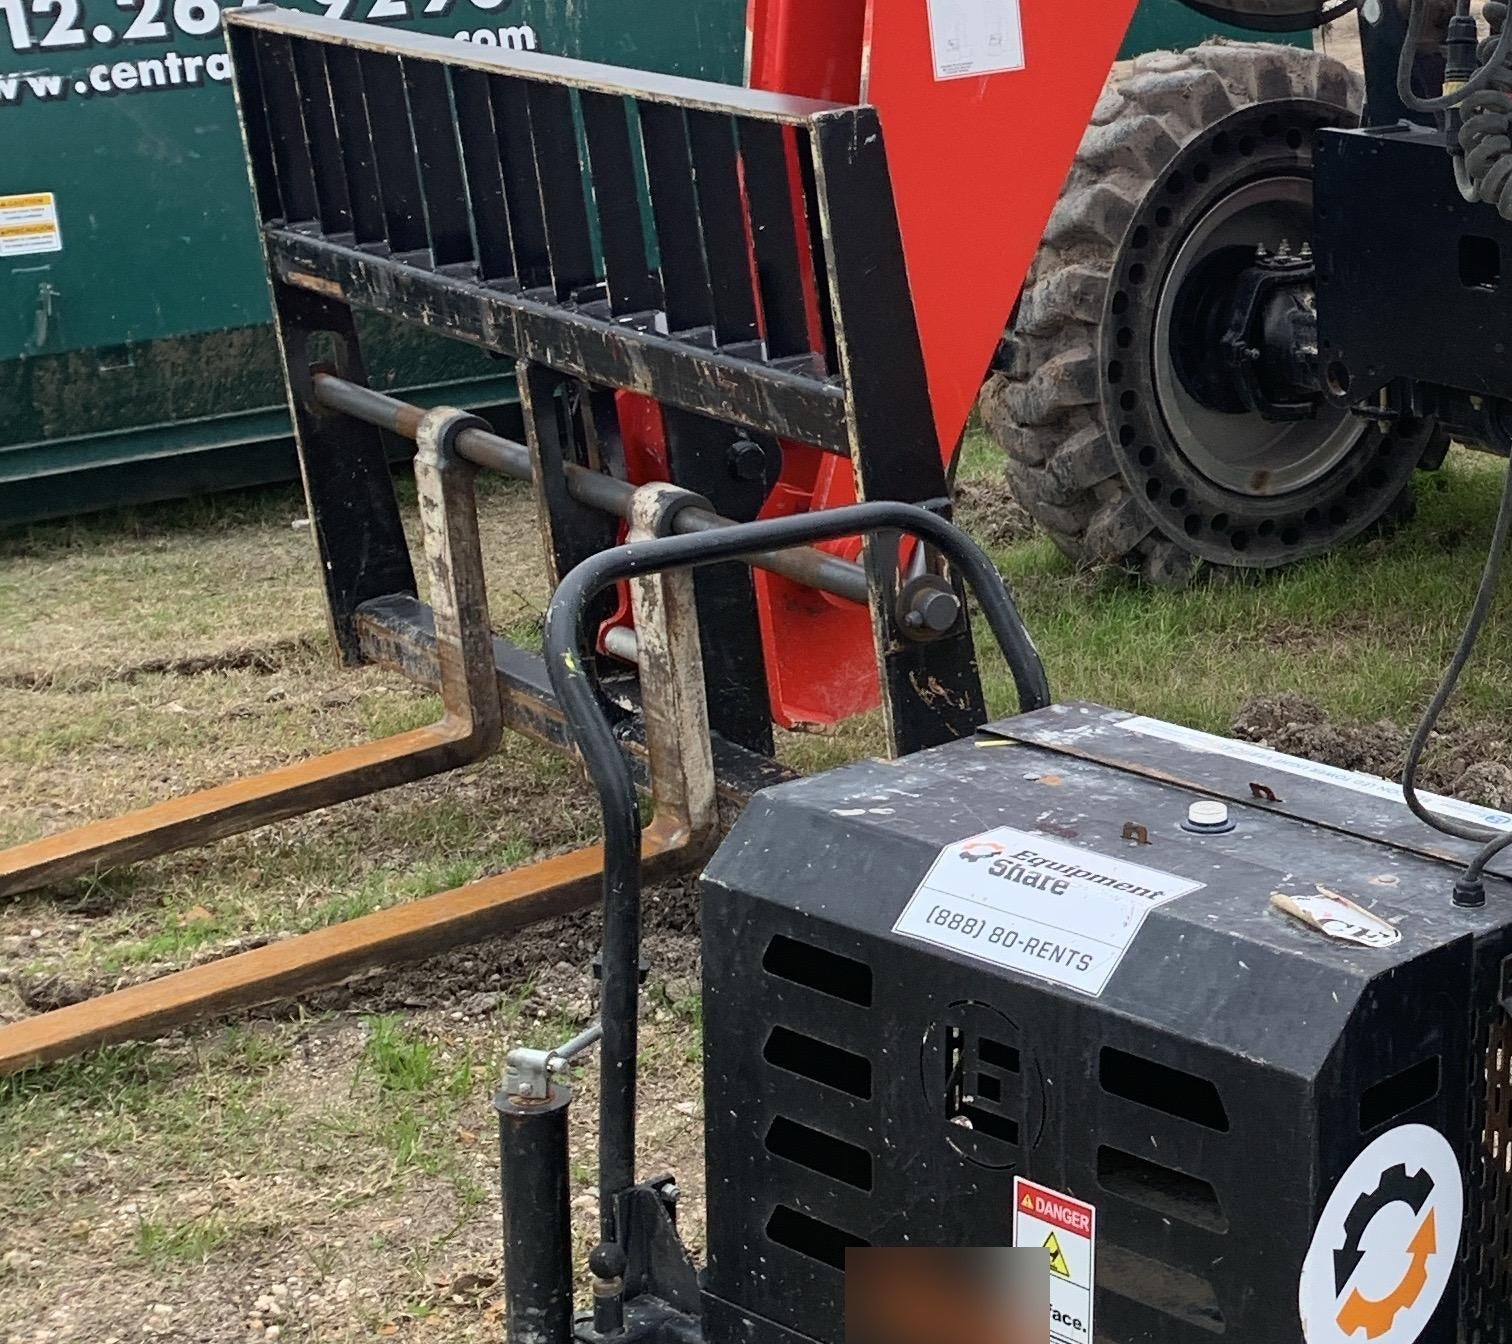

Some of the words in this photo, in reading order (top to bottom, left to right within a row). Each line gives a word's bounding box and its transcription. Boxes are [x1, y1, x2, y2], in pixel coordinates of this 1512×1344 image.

[988, 858, 1071, 897] Share
[1009, 849, 1164, 900] Equipment
[926, 905, 986, 939] (888)
[988, 926, 1093, 972] 80-RENTS
[1035, 1197, 1090, 1232] DANGER
